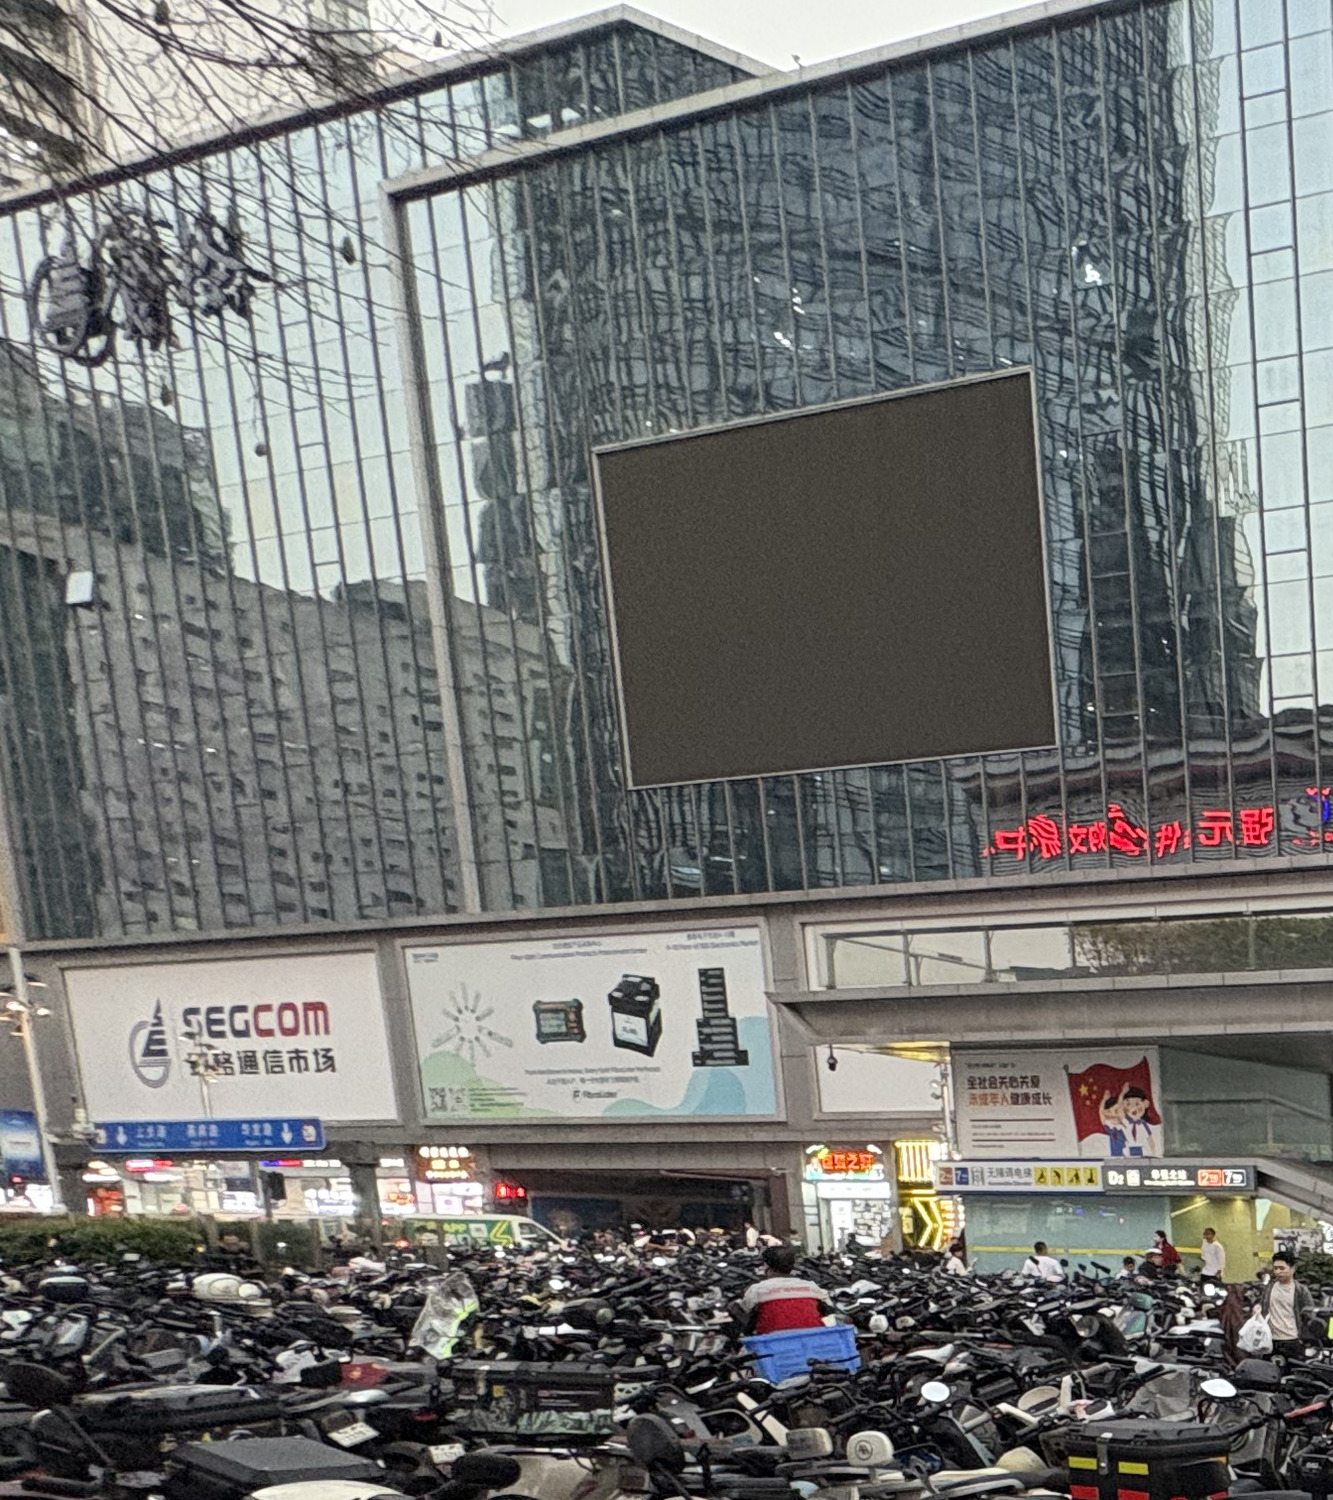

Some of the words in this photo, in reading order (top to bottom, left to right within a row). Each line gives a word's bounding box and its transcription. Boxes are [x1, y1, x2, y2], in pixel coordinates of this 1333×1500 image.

[183, 1001, 330, 1039] SEGCOM
[968, 1092, 1053, 1106] 未成年人健康成长
